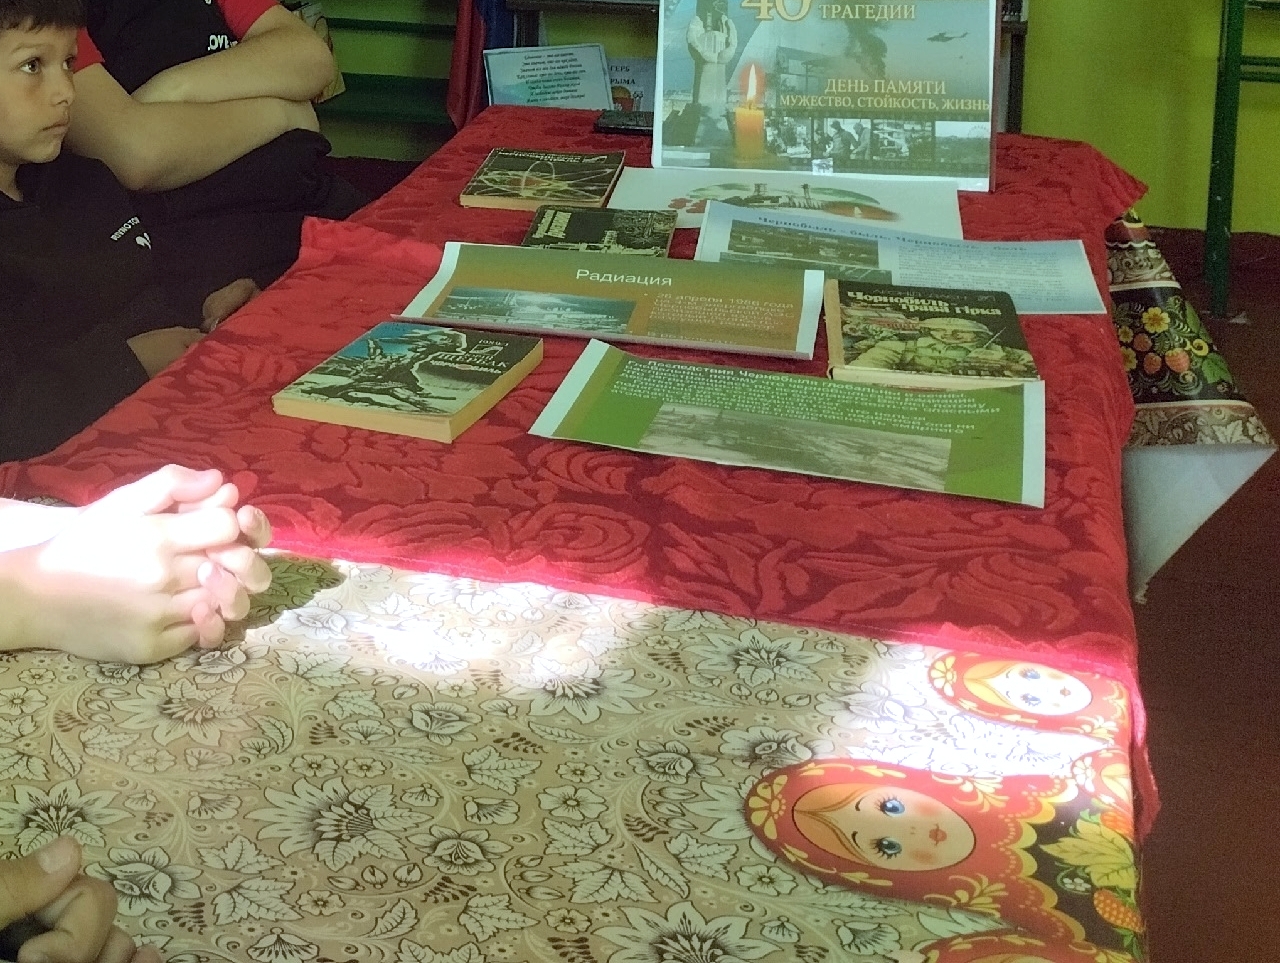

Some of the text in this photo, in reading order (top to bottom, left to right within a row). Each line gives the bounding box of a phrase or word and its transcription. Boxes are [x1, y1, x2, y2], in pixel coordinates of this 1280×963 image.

[819, 4, 916, 22] ТРАГЕДИИ
[824, 78, 946, 95] ДЕНЬ ПАМЯТИ
[780, 95, 991, 111] МУЖЕСТВО, СТОЙКОСТЬ, ЖИЗНЬ
[576, 269, 672, 287] Радиация
[847, 291, 950, 308] Чорнобиль
[648, 360, 734, 376] Последствия
[739, 369, 819, 386] Чернобыля
